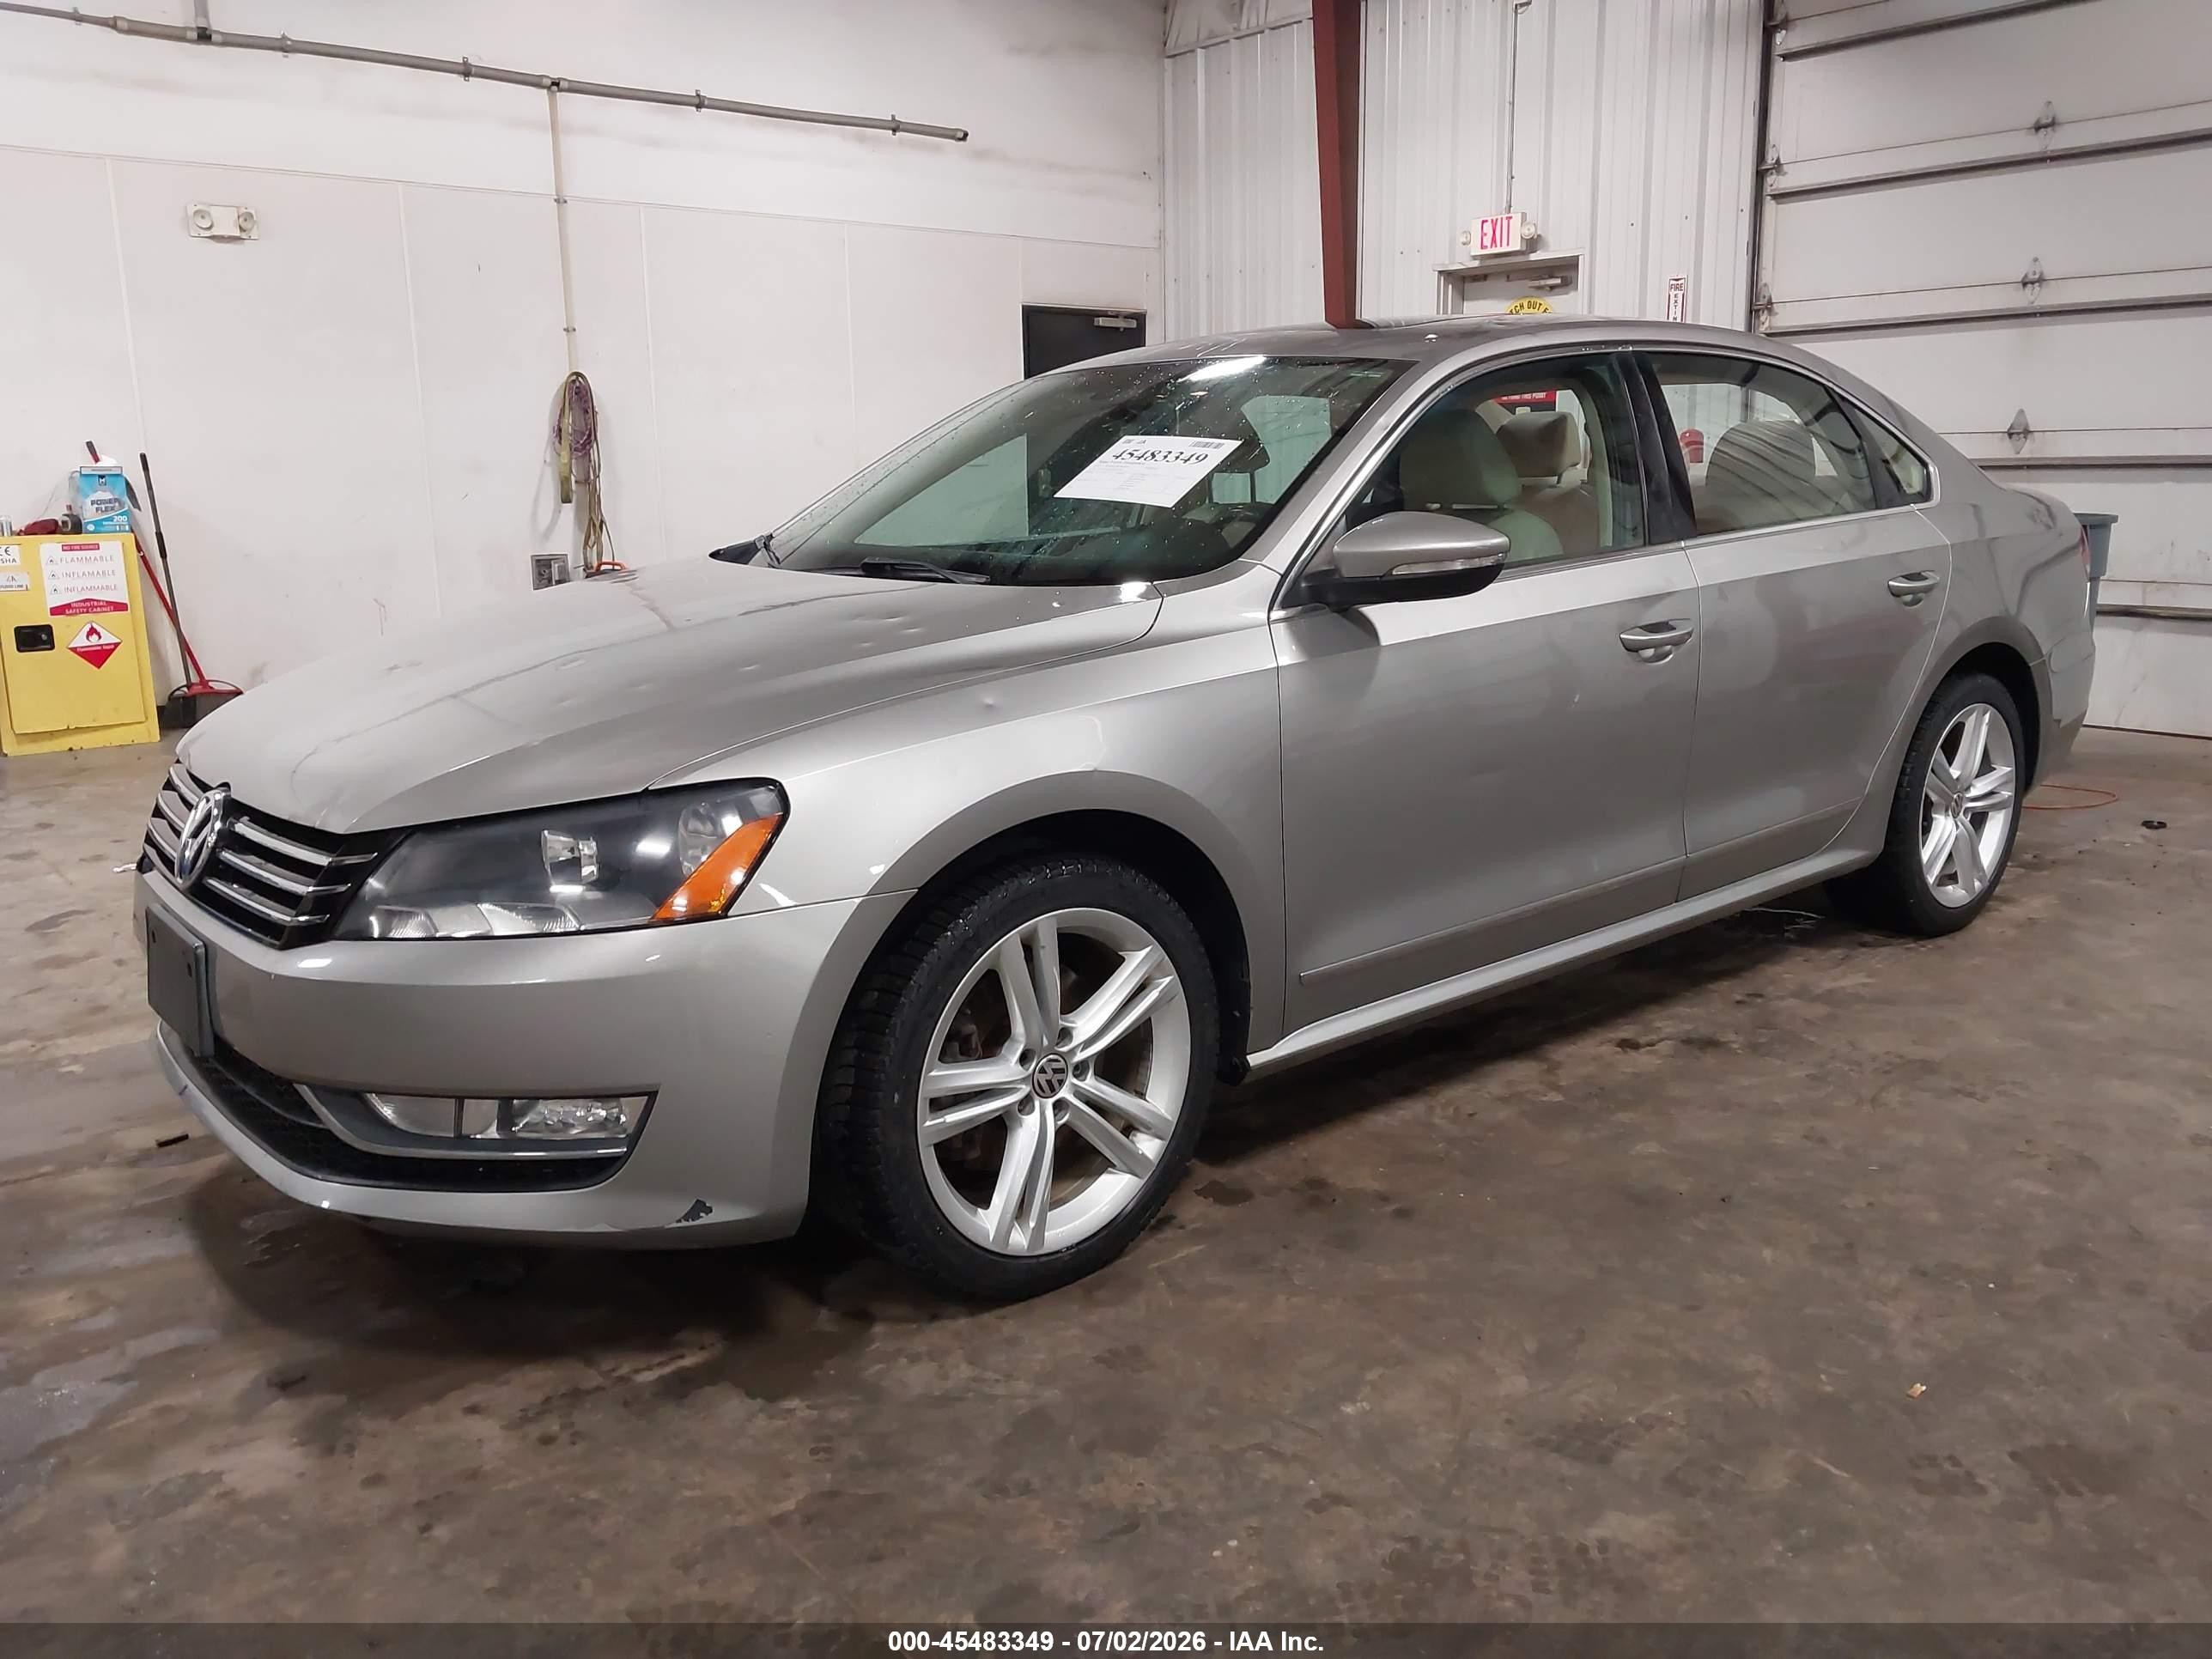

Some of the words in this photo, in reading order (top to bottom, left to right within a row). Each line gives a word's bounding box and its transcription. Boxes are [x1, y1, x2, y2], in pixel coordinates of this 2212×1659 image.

[1480, 216, 1512, 250] EXIT
[1670, 283, 1684, 292] FIRE
[1527, 300, 1542, 312] OUT
[1112, 448, 1209, 465] 45483349
[90, 498, 118, 507] POWER
[59, 555, 115, 564] FLAMMABLE
[62, 569, 116, 578] INFLAMABLE
[64, 584, 118, 593] INFLAMMABLE
